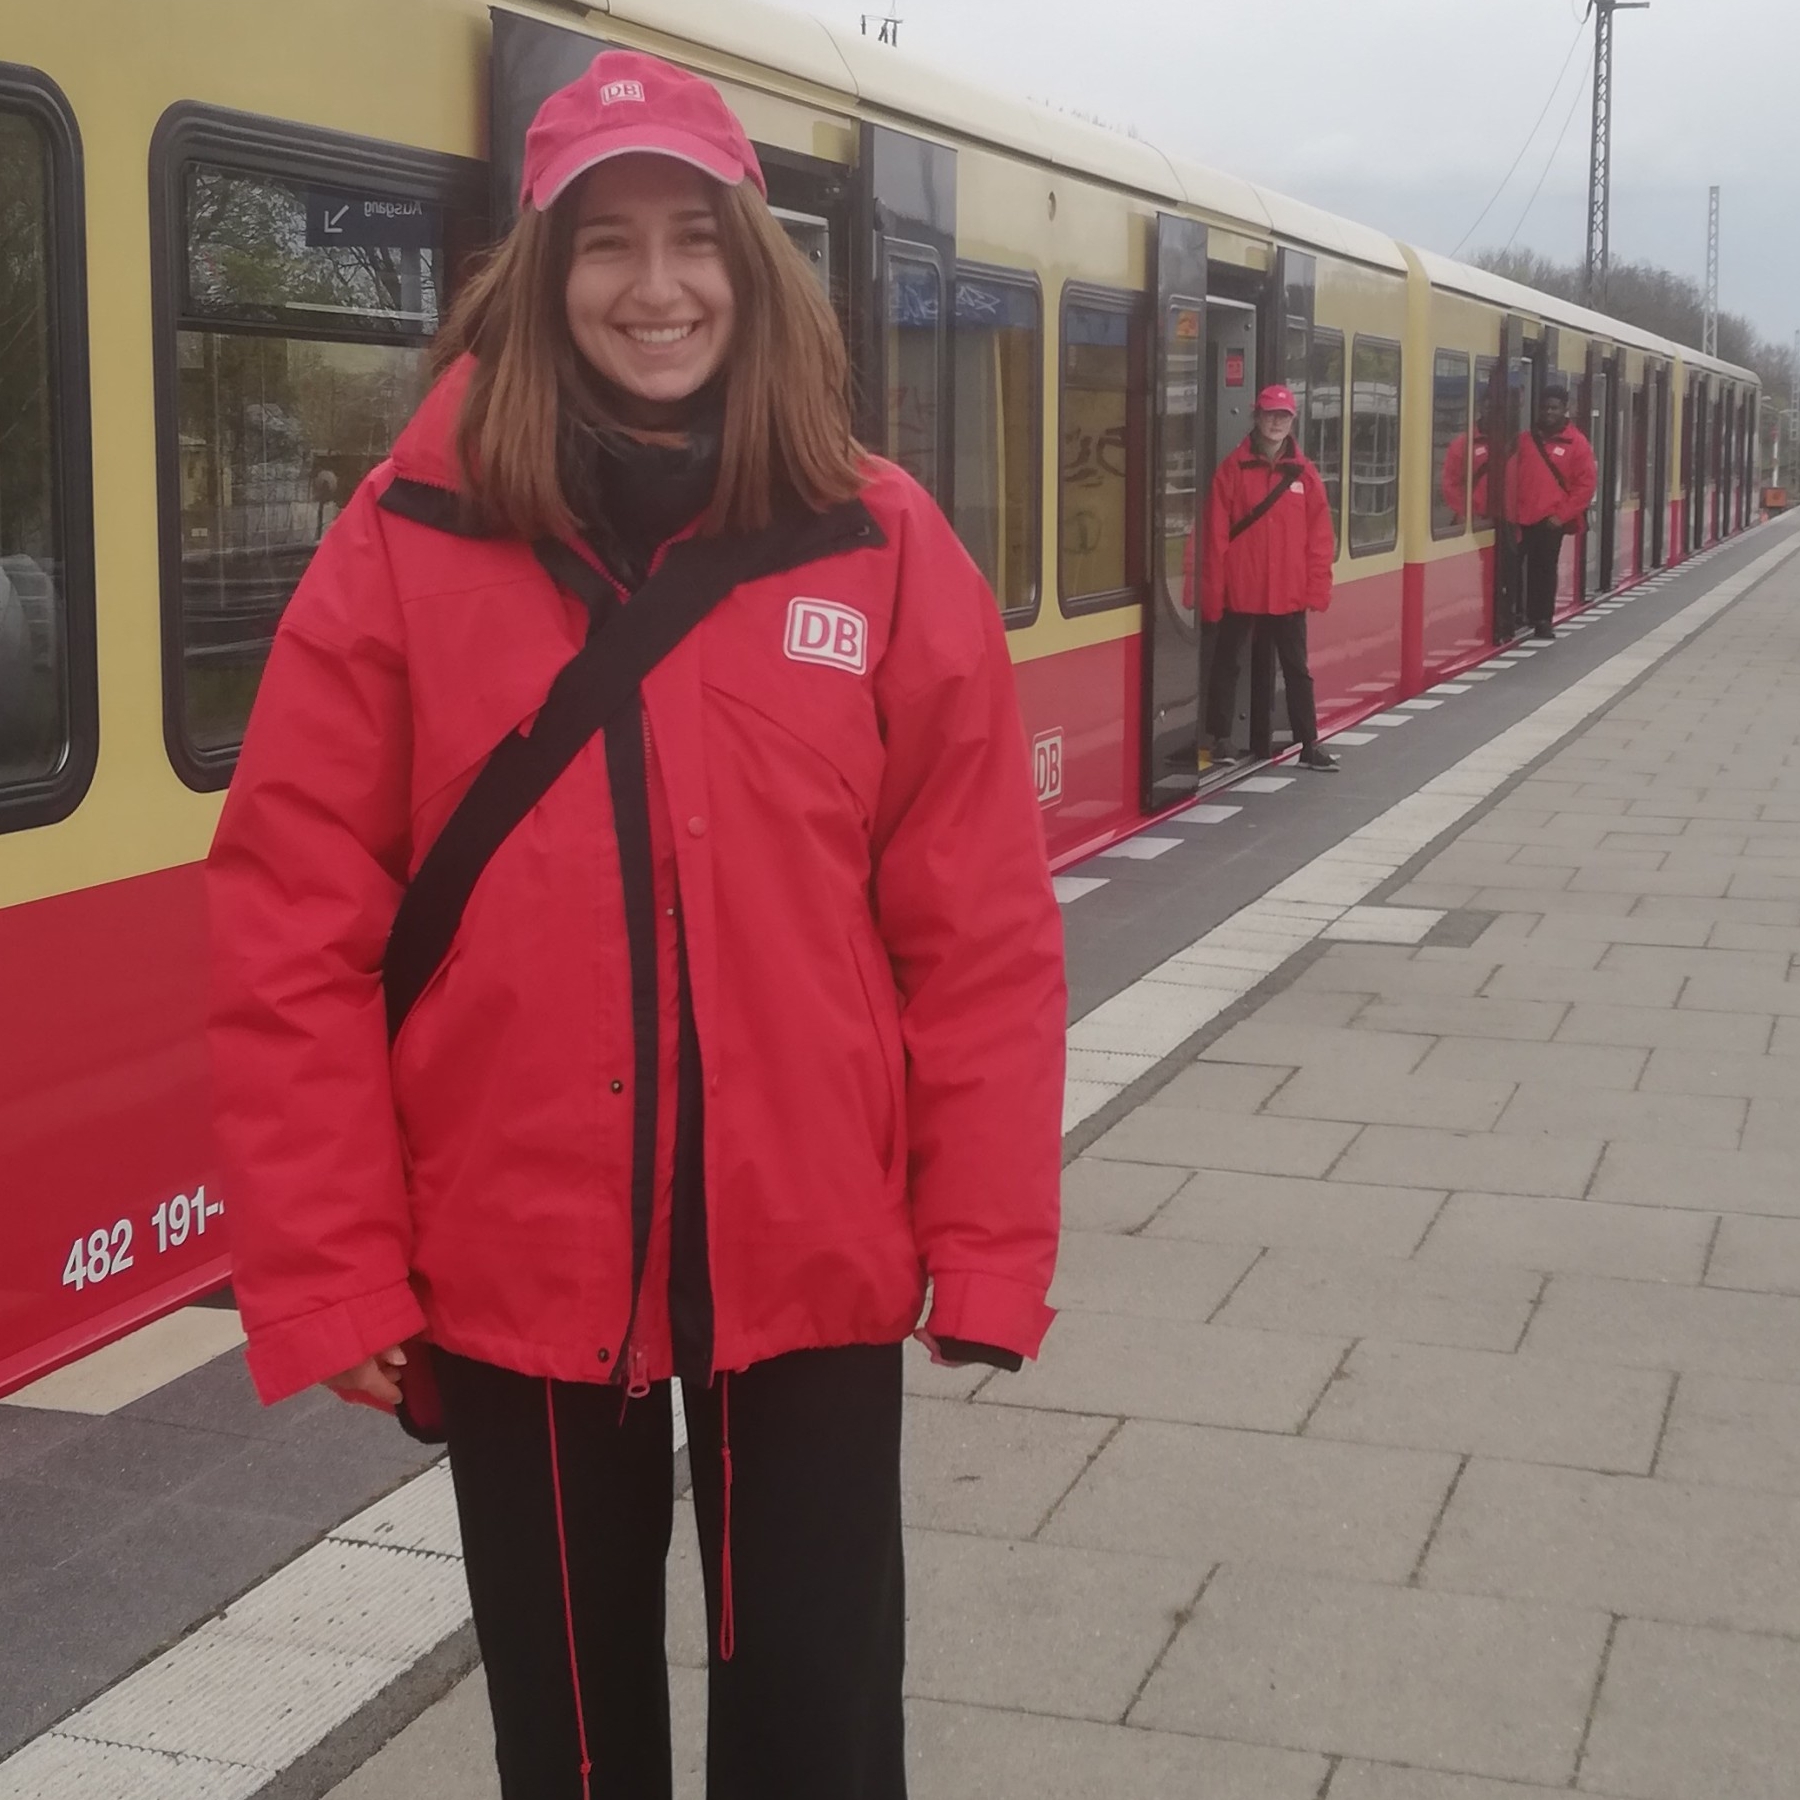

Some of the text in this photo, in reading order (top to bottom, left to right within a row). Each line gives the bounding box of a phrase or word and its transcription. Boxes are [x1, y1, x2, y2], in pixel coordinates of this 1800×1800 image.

[799, 609, 858, 658] DB
[1036, 742, 1060, 797] DB
[62, 1185, 225, 1292] 482 191-
